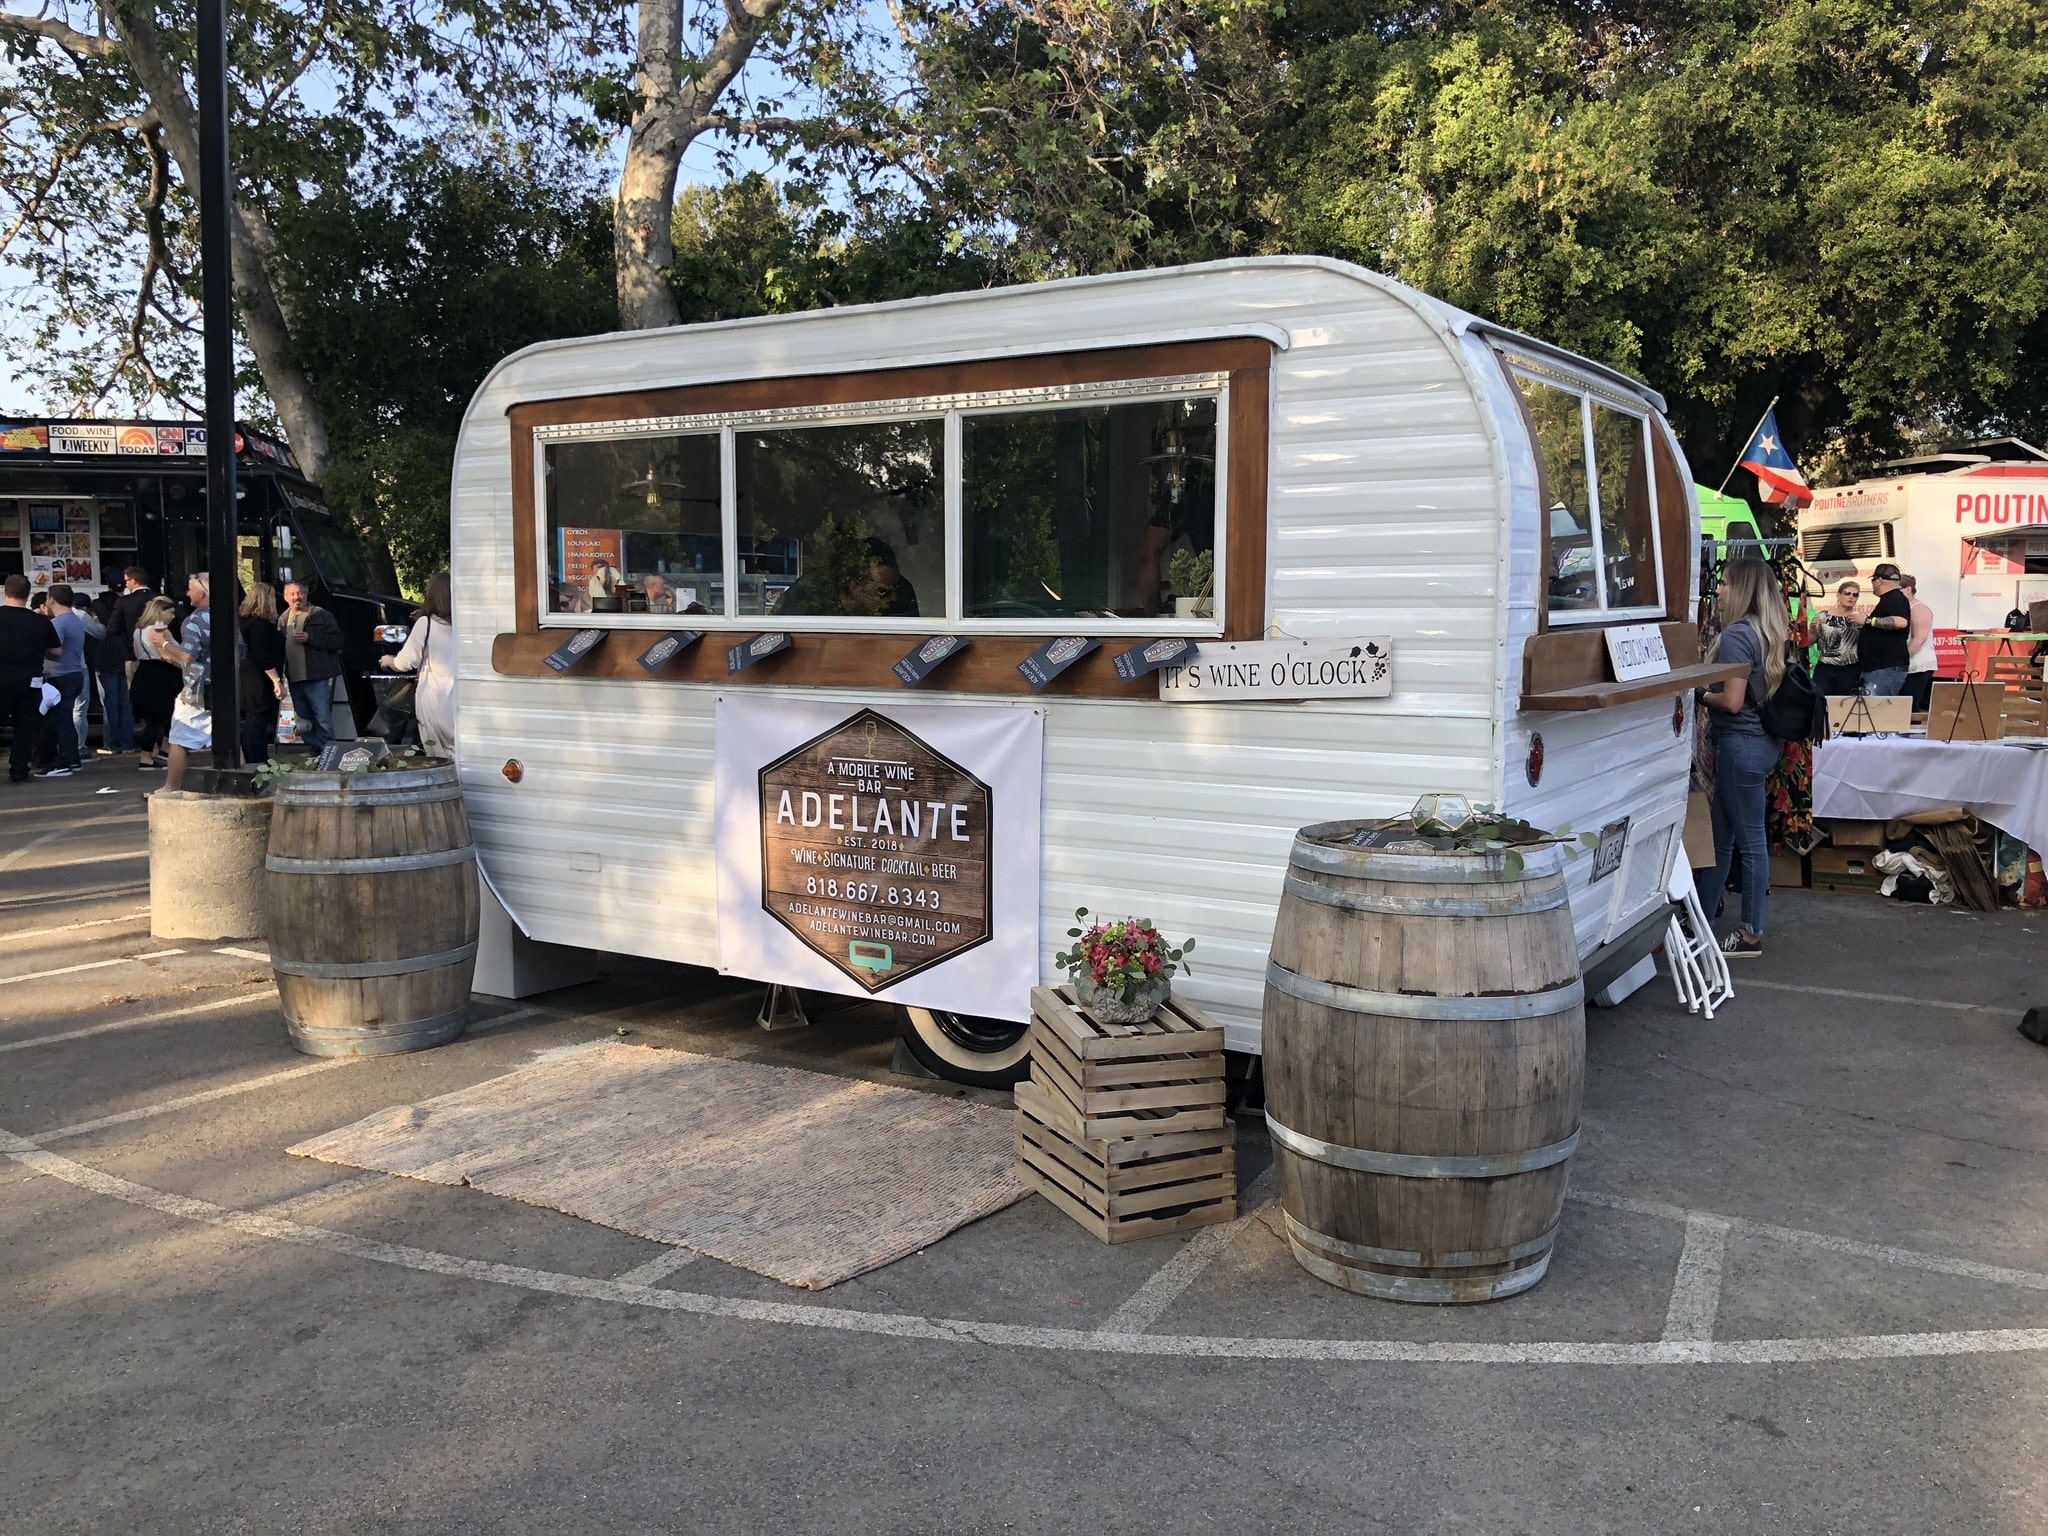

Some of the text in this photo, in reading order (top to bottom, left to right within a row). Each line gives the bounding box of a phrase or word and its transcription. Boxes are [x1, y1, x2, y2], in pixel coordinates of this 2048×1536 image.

[186, 429, 207, 442] FO
[119, 446, 156, 454] TODAY
[1956, 494, 2048, 524] POUTIN
[1165, 653, 1367, 689] IT'S WINE O'CLOCK
[828, 761, 915, 781] A MOBILE WINE
[858, 779, 882, 794] BAR
[776, 789, 970, 842] ADELANTE
[844, 838, 897, 851] EST. 2018
[823, 850, 876, 872] SIGNATURE
[881, 857, 925, 877] COCKTAIL
[931, 863, 957, 880] BEER
[806, 876, 940, 910] 818.667.8343
[788, 902, 961, 935] ADELANTEWINEBAR@GMAIL.COM
[809, 919, 936, 946] ADELANTEWINEBAR.COM
